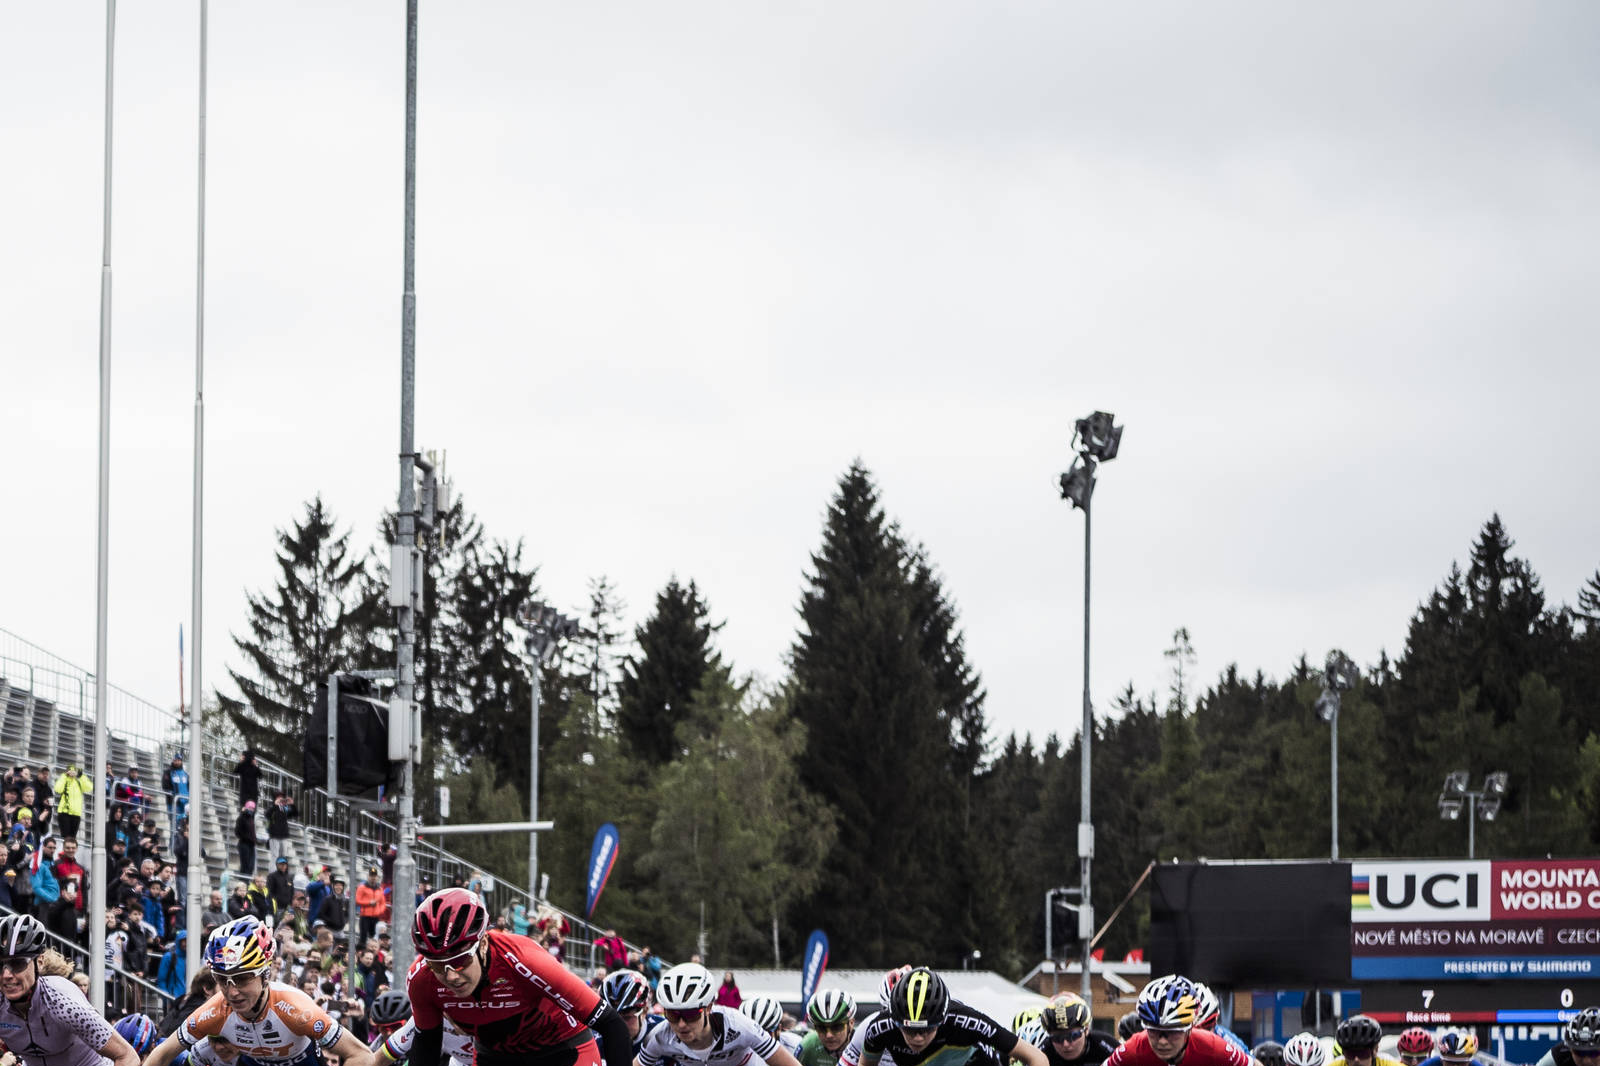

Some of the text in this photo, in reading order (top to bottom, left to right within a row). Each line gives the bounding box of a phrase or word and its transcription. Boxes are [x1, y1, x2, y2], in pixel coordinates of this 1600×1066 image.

[1376, 873, 1479, 910] UCI
[1500, 891, 1583, 910] WORLD
[1354, 928, 1395, 945] NOVÉ
[1399, 928, 1451, 945] MĚSTO
[1455, 930, 1476, 945] NA
[1444, 960, 1591, 974] PRESENTED BY SHIMANO
[504, 952, 574, 1012] FOCUS
[443, 1001, 521, 1009] FOCUS
[1422, 988, 1574, 1008] 7 0
